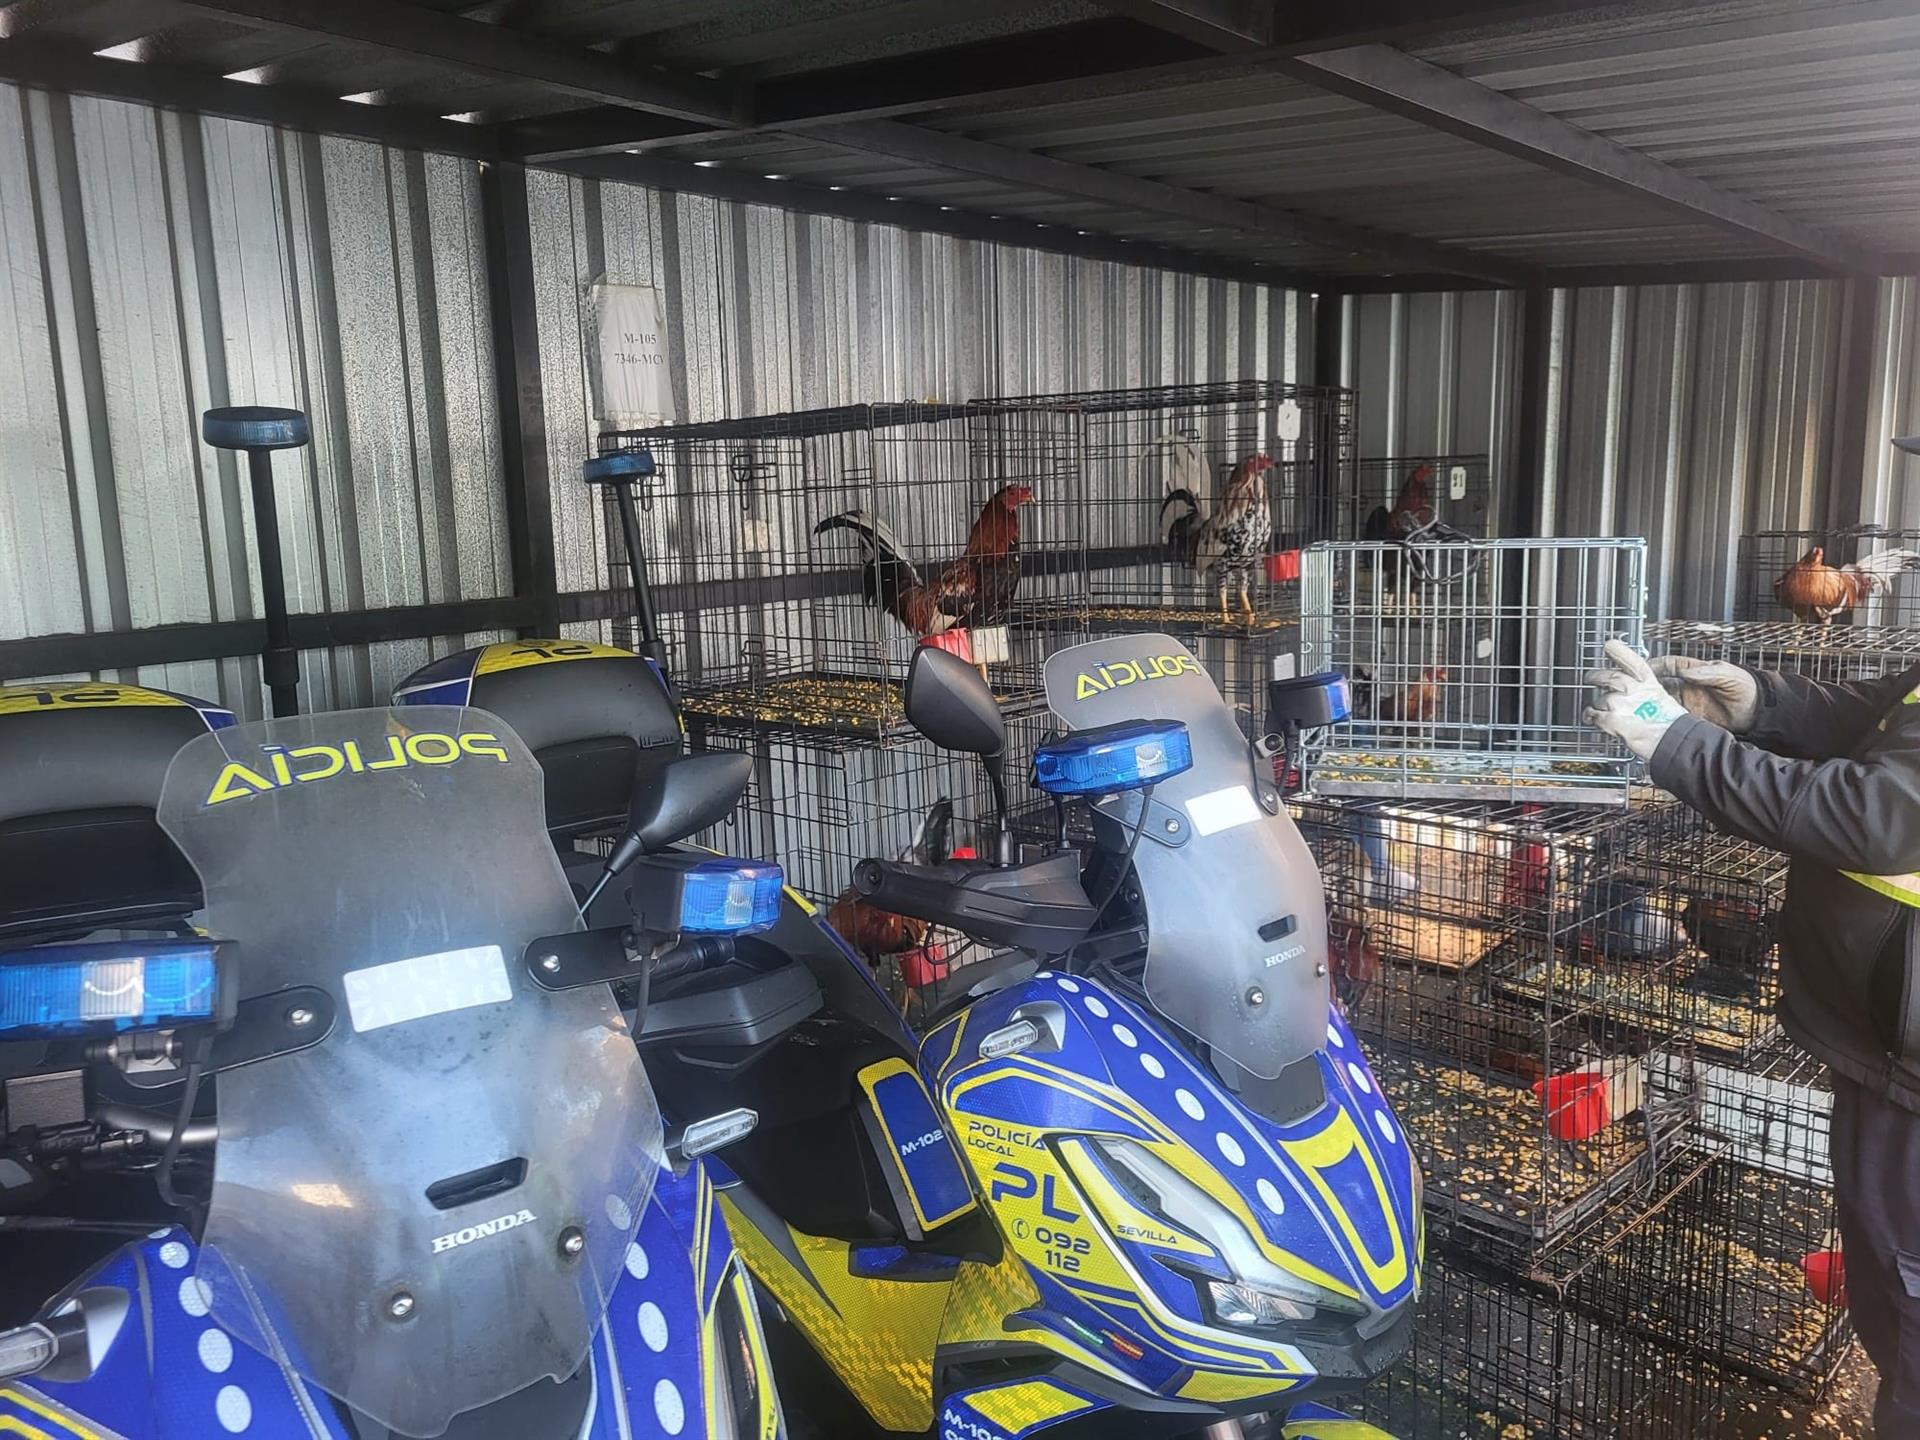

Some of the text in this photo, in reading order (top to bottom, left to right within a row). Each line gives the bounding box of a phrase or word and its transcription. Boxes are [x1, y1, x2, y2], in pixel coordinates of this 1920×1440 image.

[623, 333, 657, 345] M-105
[1264, 944, 1306, 968] HONDA
[901, 1129, 944, 1156] M-102
[968, 1136, 1015, 1157] LOCAL
[969, 1121, 1046, 1150] POLICÍA
[991, 1162, 1080, 1224] PL
[431, 1208, 537, 1254] HONDA
[1035, 1226, 1091, 1255] 092
[1116, 1224, 1178, 1245] SEVILLA
[1045, 1250, 1080, 1273] 112
[944, 1408, 1006, 1440] M-10
